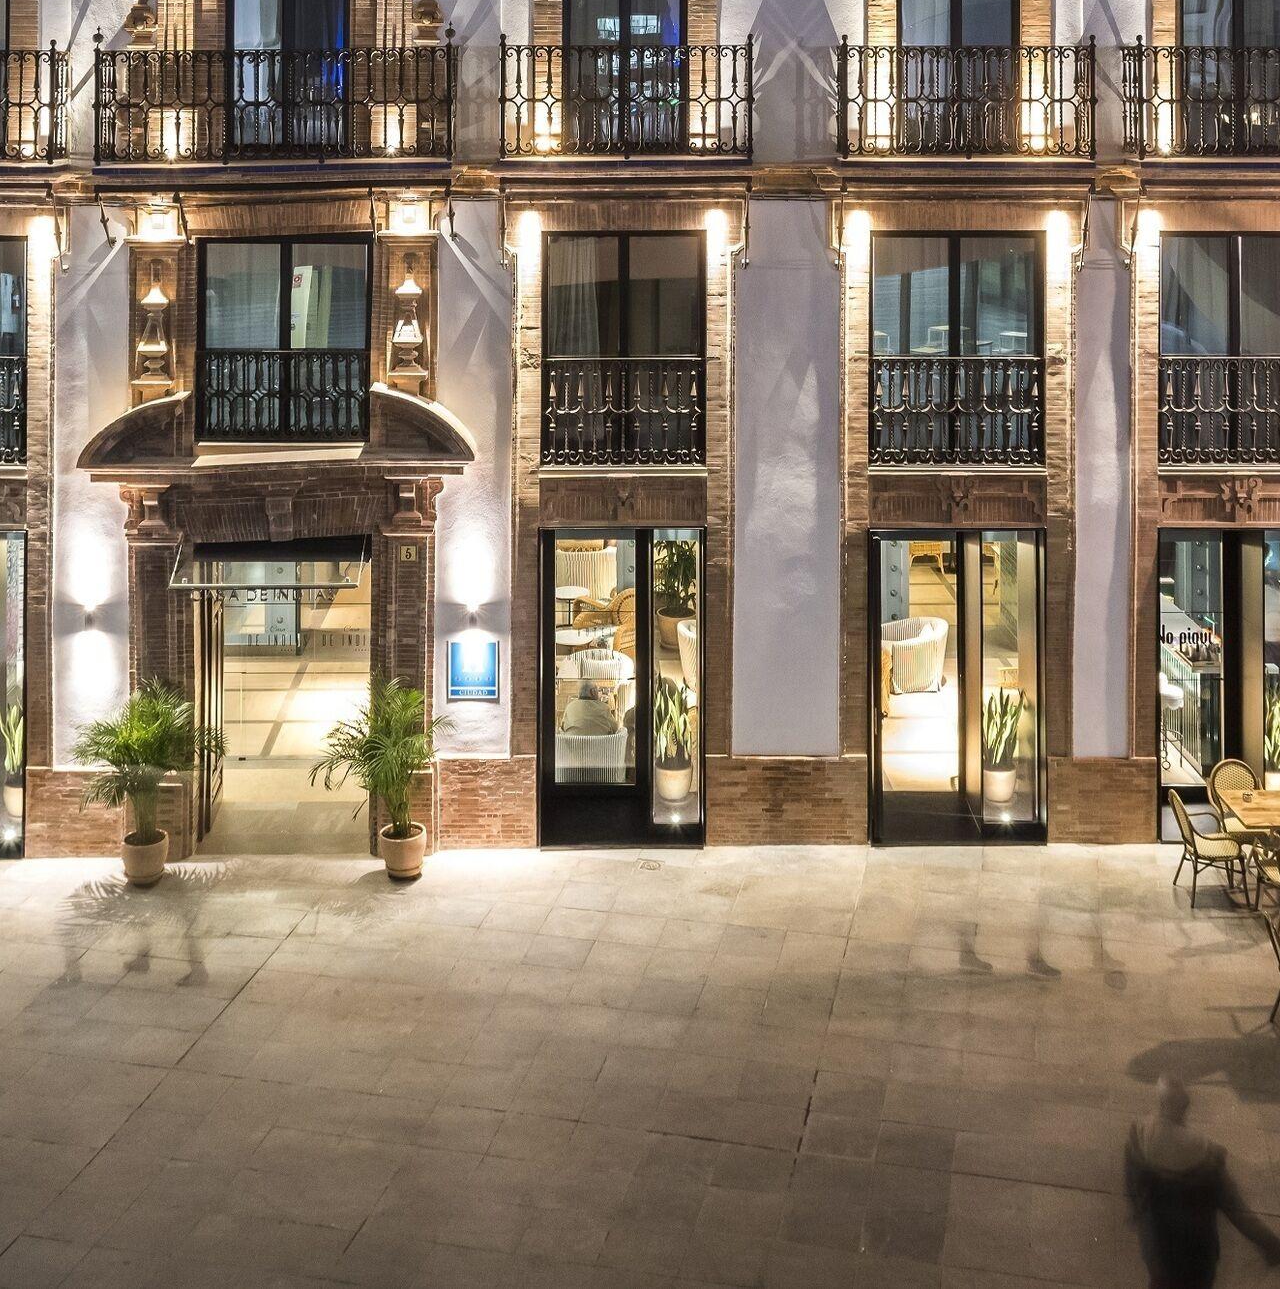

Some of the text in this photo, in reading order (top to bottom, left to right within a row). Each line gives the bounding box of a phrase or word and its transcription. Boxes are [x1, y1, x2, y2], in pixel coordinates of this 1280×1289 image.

[405, 547, 412, 560] 5
[246, 589, 269, 602] DE
[247, 634, 309, 647] DE INDIS
[322, 634, 366, 646] DE INDI
